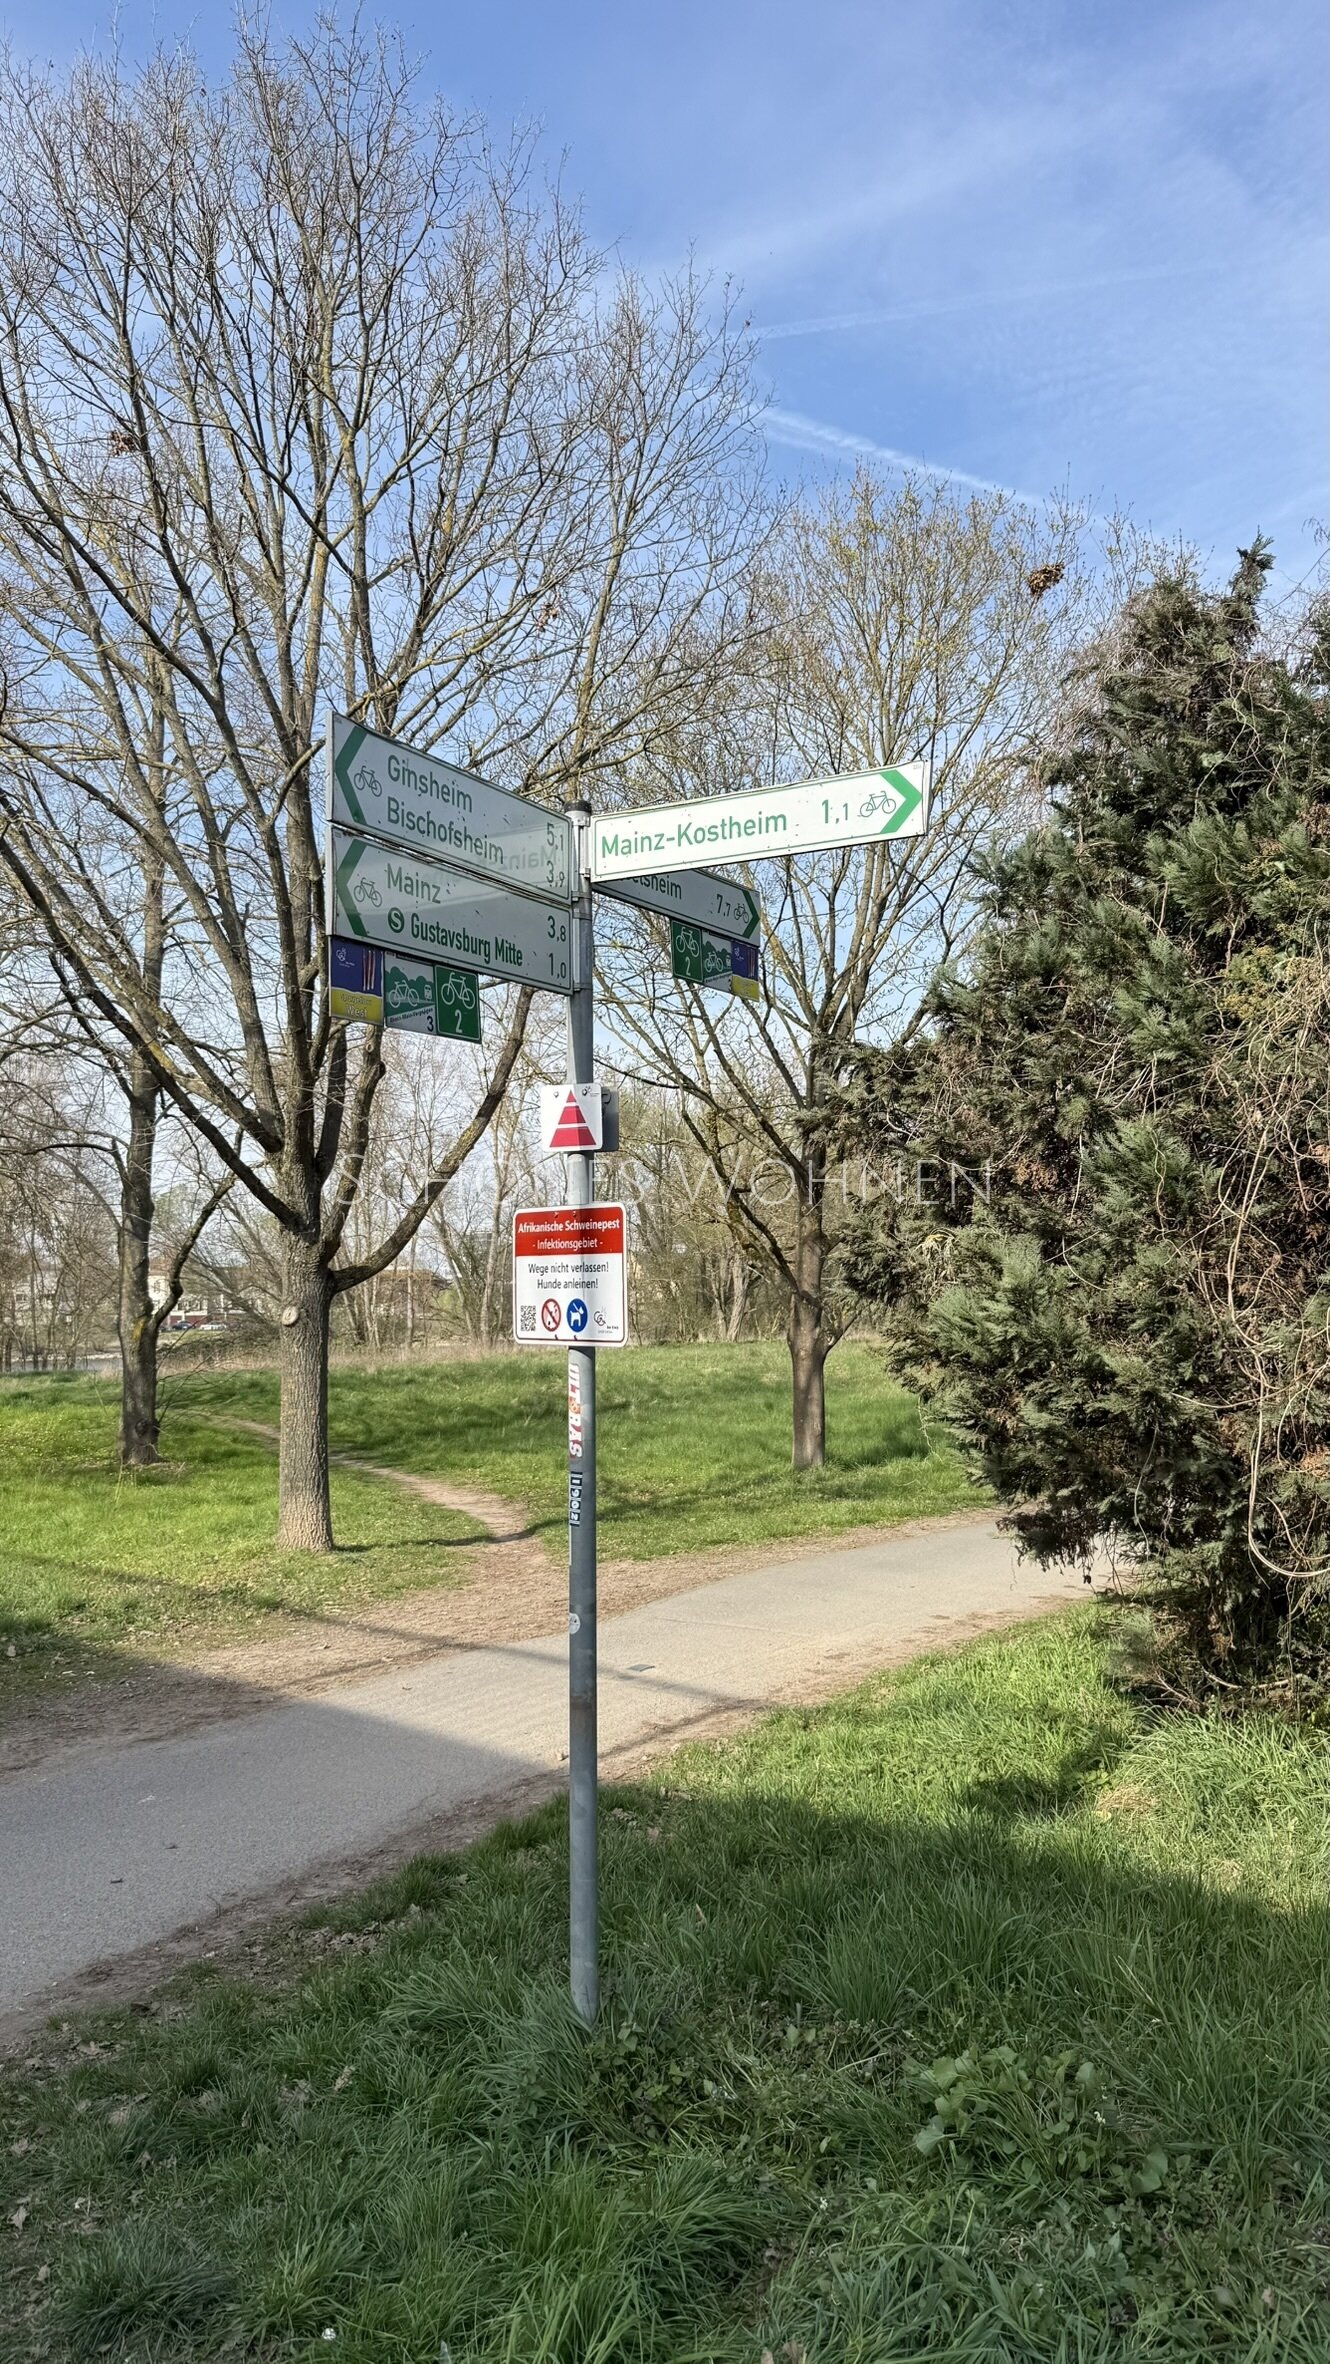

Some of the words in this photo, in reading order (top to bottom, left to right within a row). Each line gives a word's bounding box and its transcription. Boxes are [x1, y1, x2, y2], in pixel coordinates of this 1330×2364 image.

[388, 755, 472, 812] Ginsheim
[546, 822, 564, 851] 5,1
[601, 811, 787, 859] Mainz-Kostheim
[821, 799, 849, 825] 1,1
[387, 796, 504, 864] Bischofsheim
[546, 860, 565, 888] 3,9
[387, 863, 441, 904] Mainz
[547, 916, 567, 942] 3,8
[716, 893, 732, 918] 7,7
[411, 912, 490, 965] Gustavsburg
[495, 936, 523, 967] Mitte
[548, 953, 567, 979] 1,0
[683, 956, 692, 977] 2
[426, 1015, 434, 1032] 3
[454, 1009, 463, 1033] 2
[518, 1221, 564, 1233] Afrikanische
[565, 1218, 620, 1232] Schweinepest
[537, 1238, 598, 1251] Infektionsgebiet
[528, 1263, 549, 1276] Wege
[551, 1262, 569, 1273] nicht
[571, 1261, 609, 1273] verlassen!
[537, 1278, 562, 1289] Hunde
[563, 1278, 599, 1289] anleinen!
